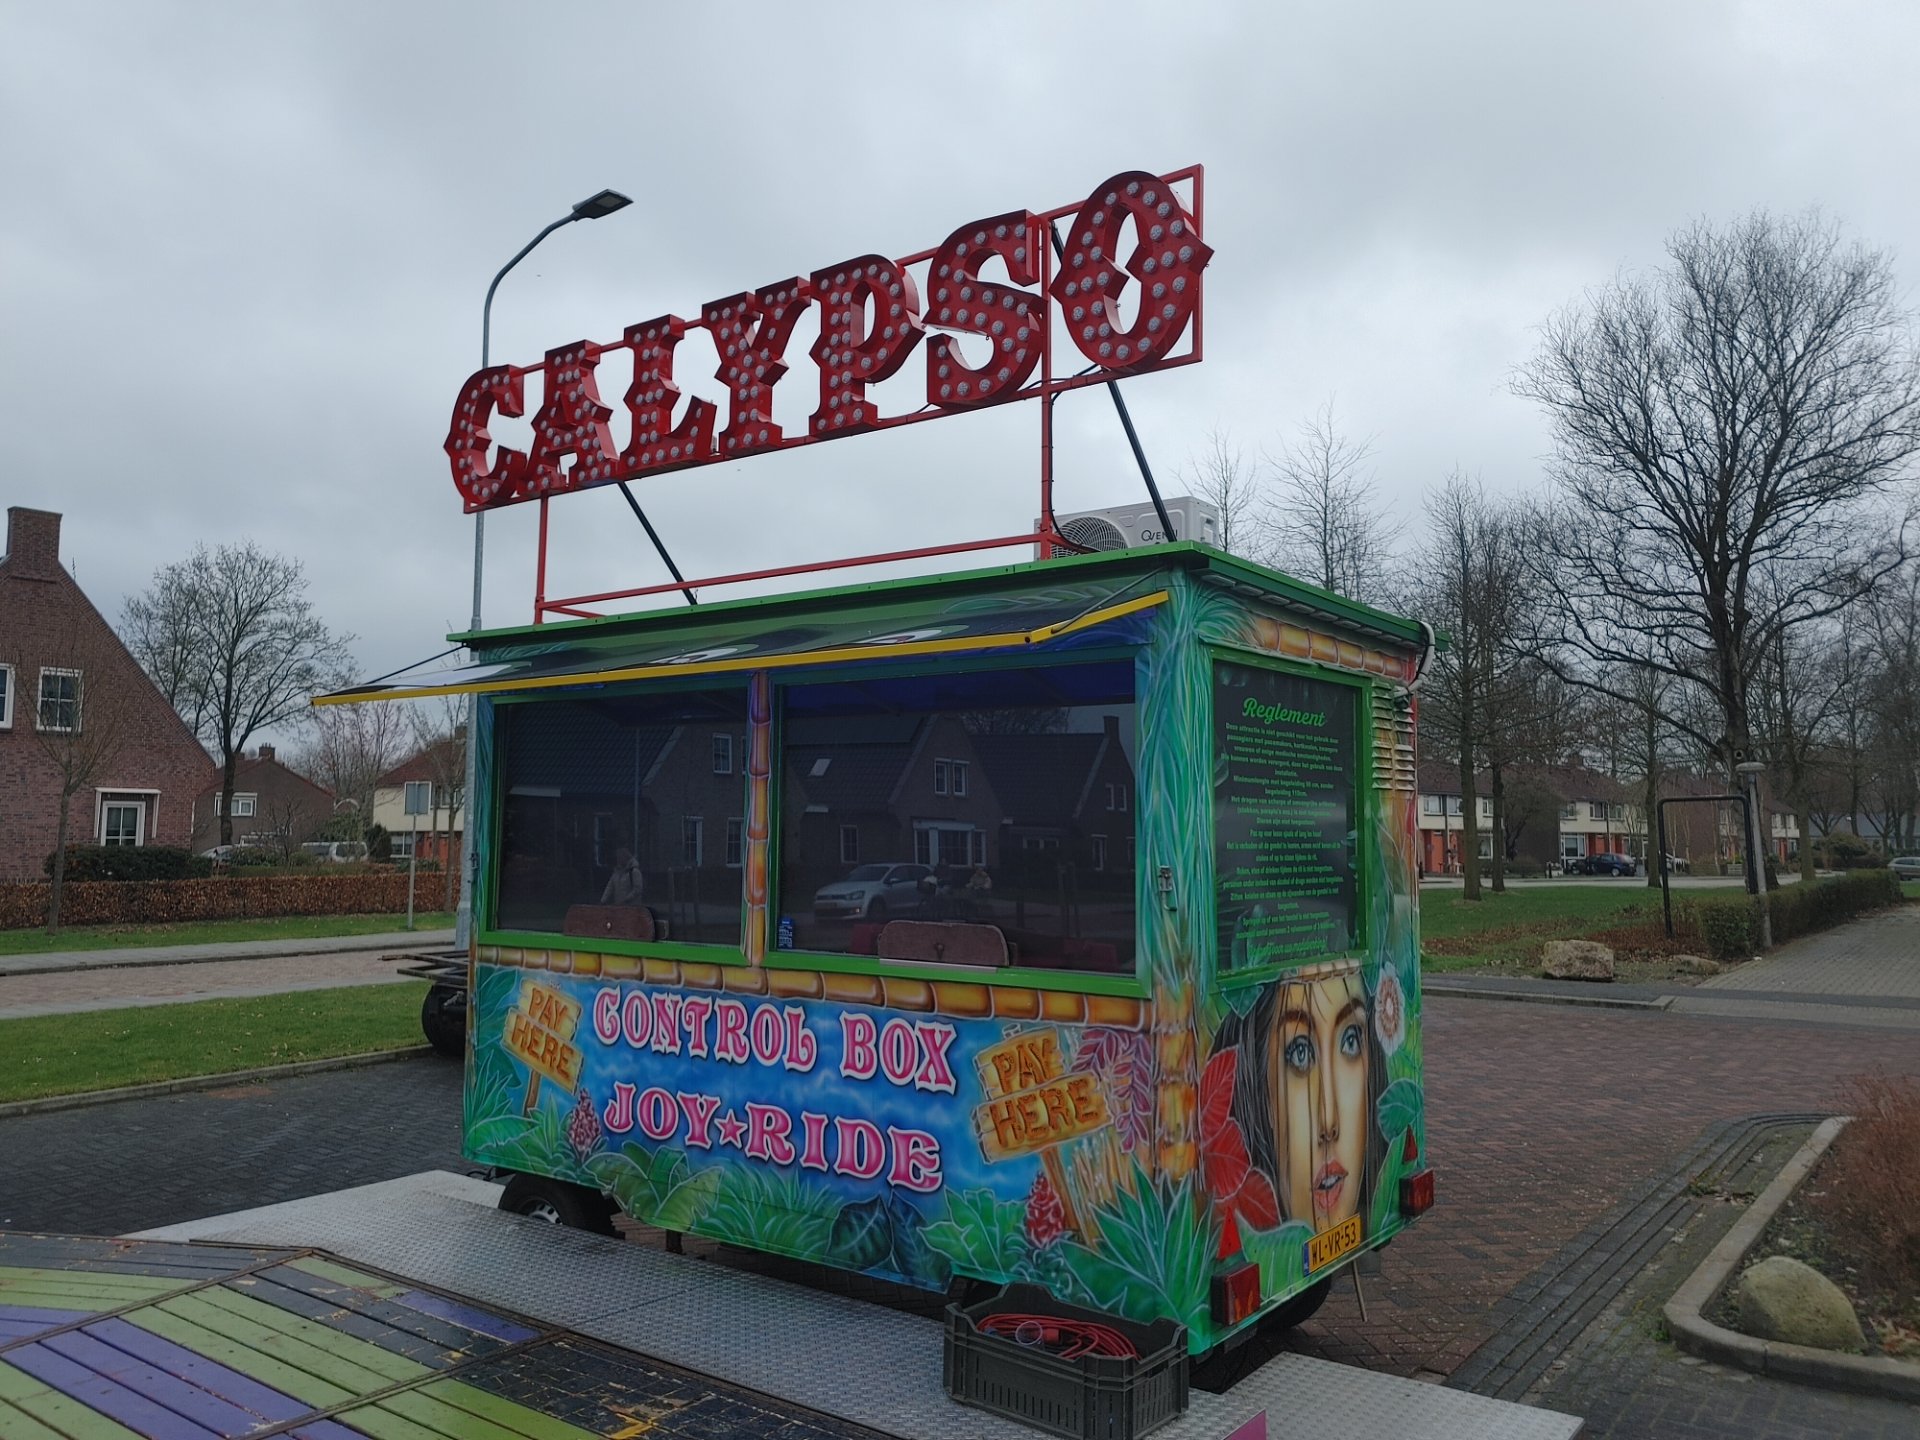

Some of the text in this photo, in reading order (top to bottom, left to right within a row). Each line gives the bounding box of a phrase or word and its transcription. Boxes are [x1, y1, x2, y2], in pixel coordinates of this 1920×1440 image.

[444, 171, 1213, 507] CALYPSO
[1242, 697, 1326, 727] Reglement
[528, 987, 568, 1031] PAY
[511, 1014, 576, 1081] HERE
[593, 985, 957, 1096] CONTROL BOX
[991, 1037, 1052, 1094] PAY
[989, 1078, 1099, 1148] HERE
[1311, 1221, 1357, 1266] WL-VR-53
